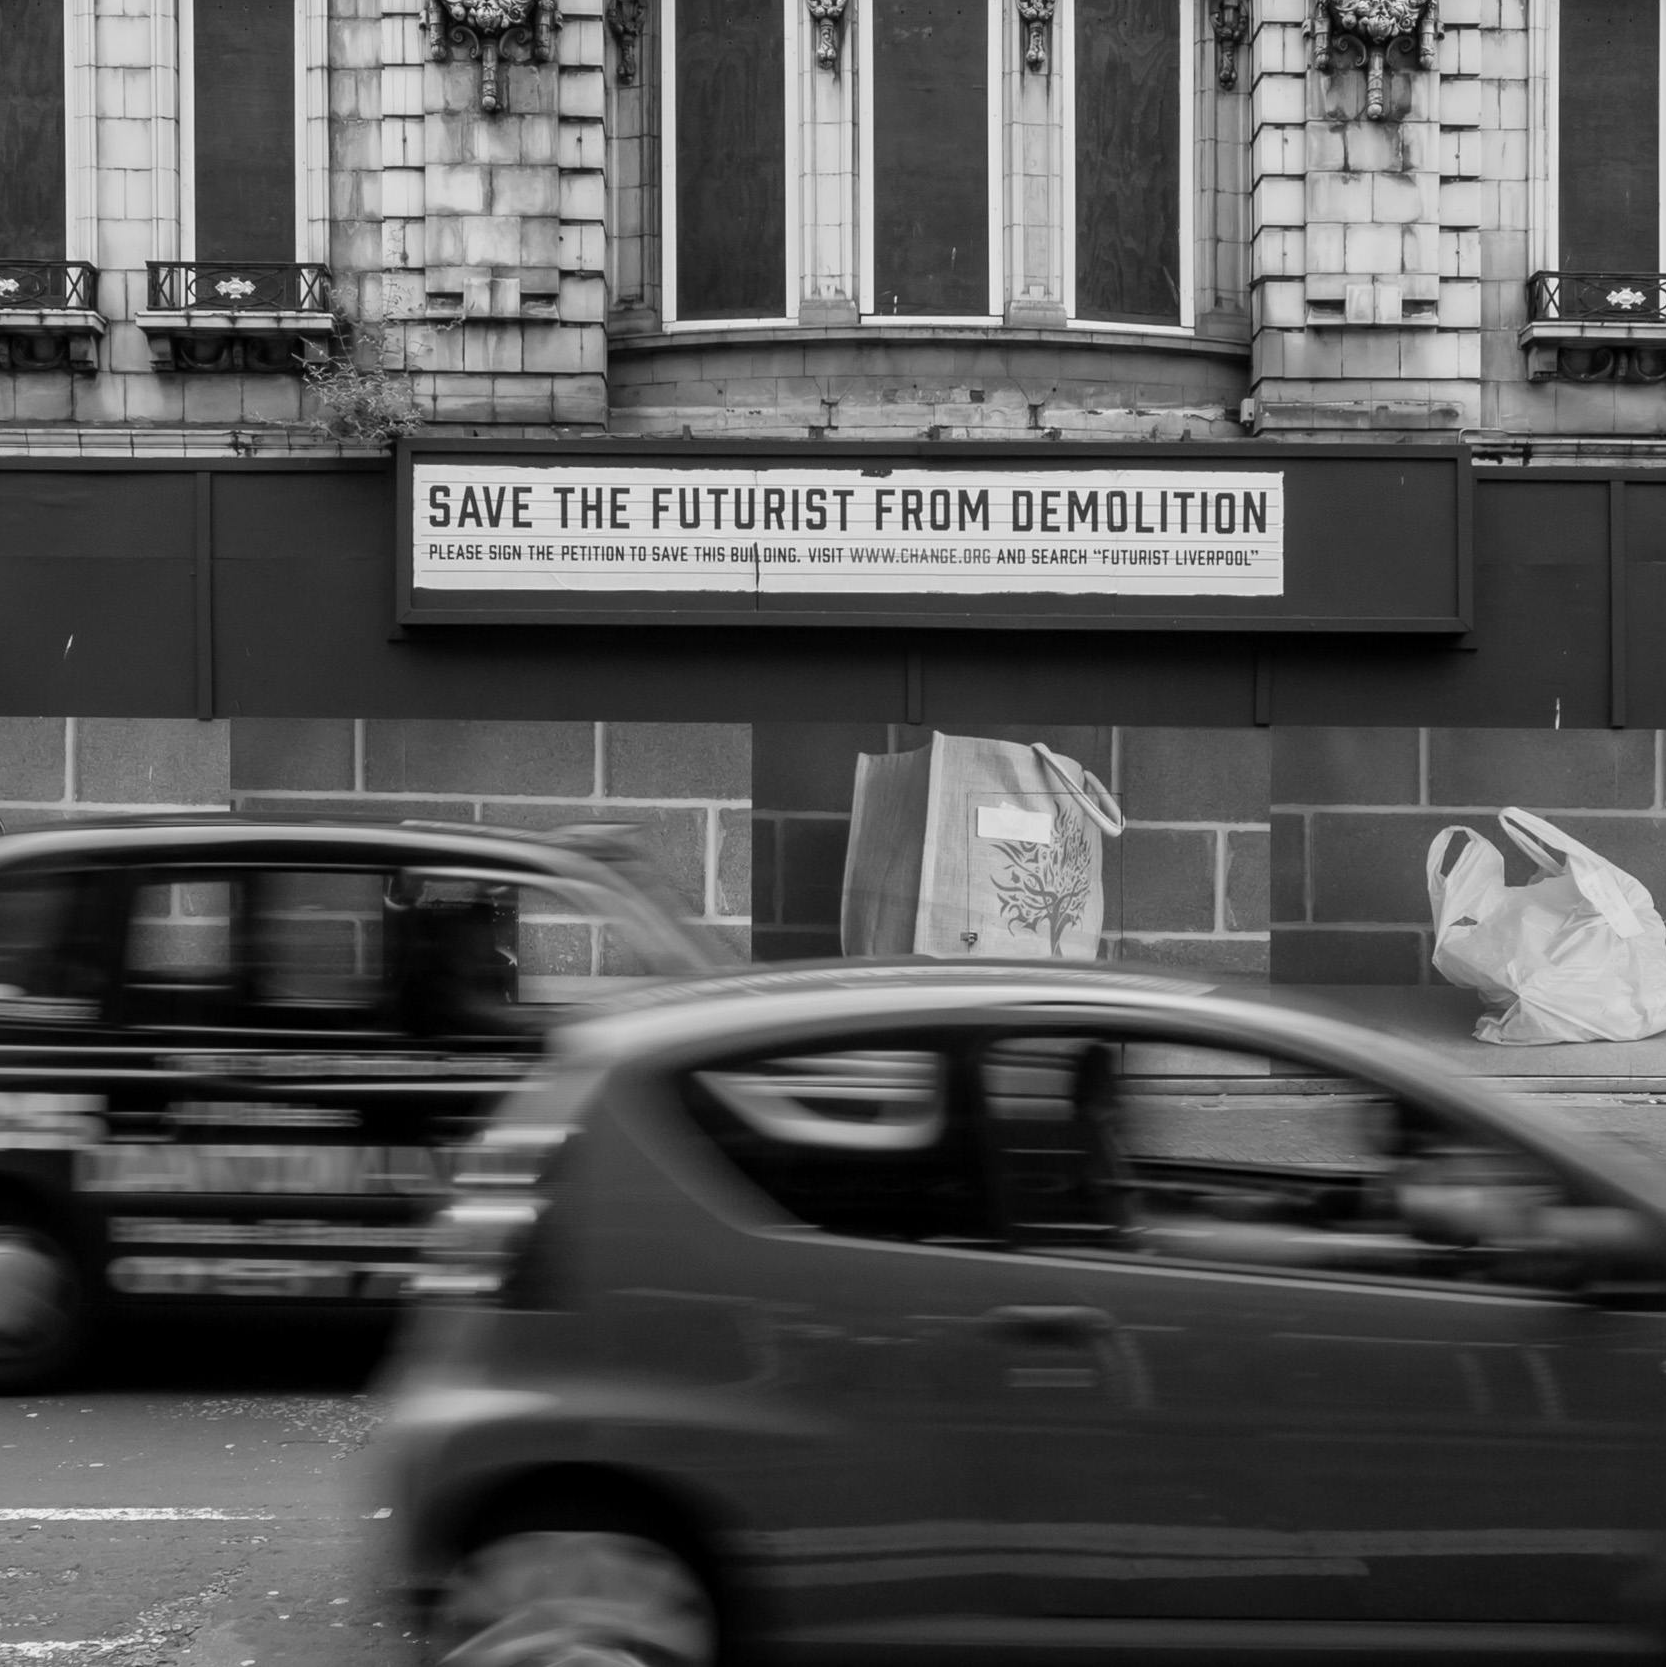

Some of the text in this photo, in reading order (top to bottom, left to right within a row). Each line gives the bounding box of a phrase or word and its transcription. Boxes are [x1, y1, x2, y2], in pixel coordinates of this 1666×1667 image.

[429, 485, 1267, 535] SAVE THE FUTURIST FROM DEMOLITION
[429, 544, 483, 560] PLEASE
[488, 544, 522, 560] SIGN
[528, 545, 554, 561] THE
[561, 545, 625, 562] PETITION
[629, 546, 647, 562] TO
[652, 546, 688, 562] SAVE
[694, 546, 725, 563] THIS
[730, 546, 801, 563] BUILDING.
[808, 547, 844, 563] VISIT
[850, 547, 991, 565] WWW.CHANGE.ORG
[997, 548, 1026, 564] AND
[1032, 549, 1087, 565] SEARCH
